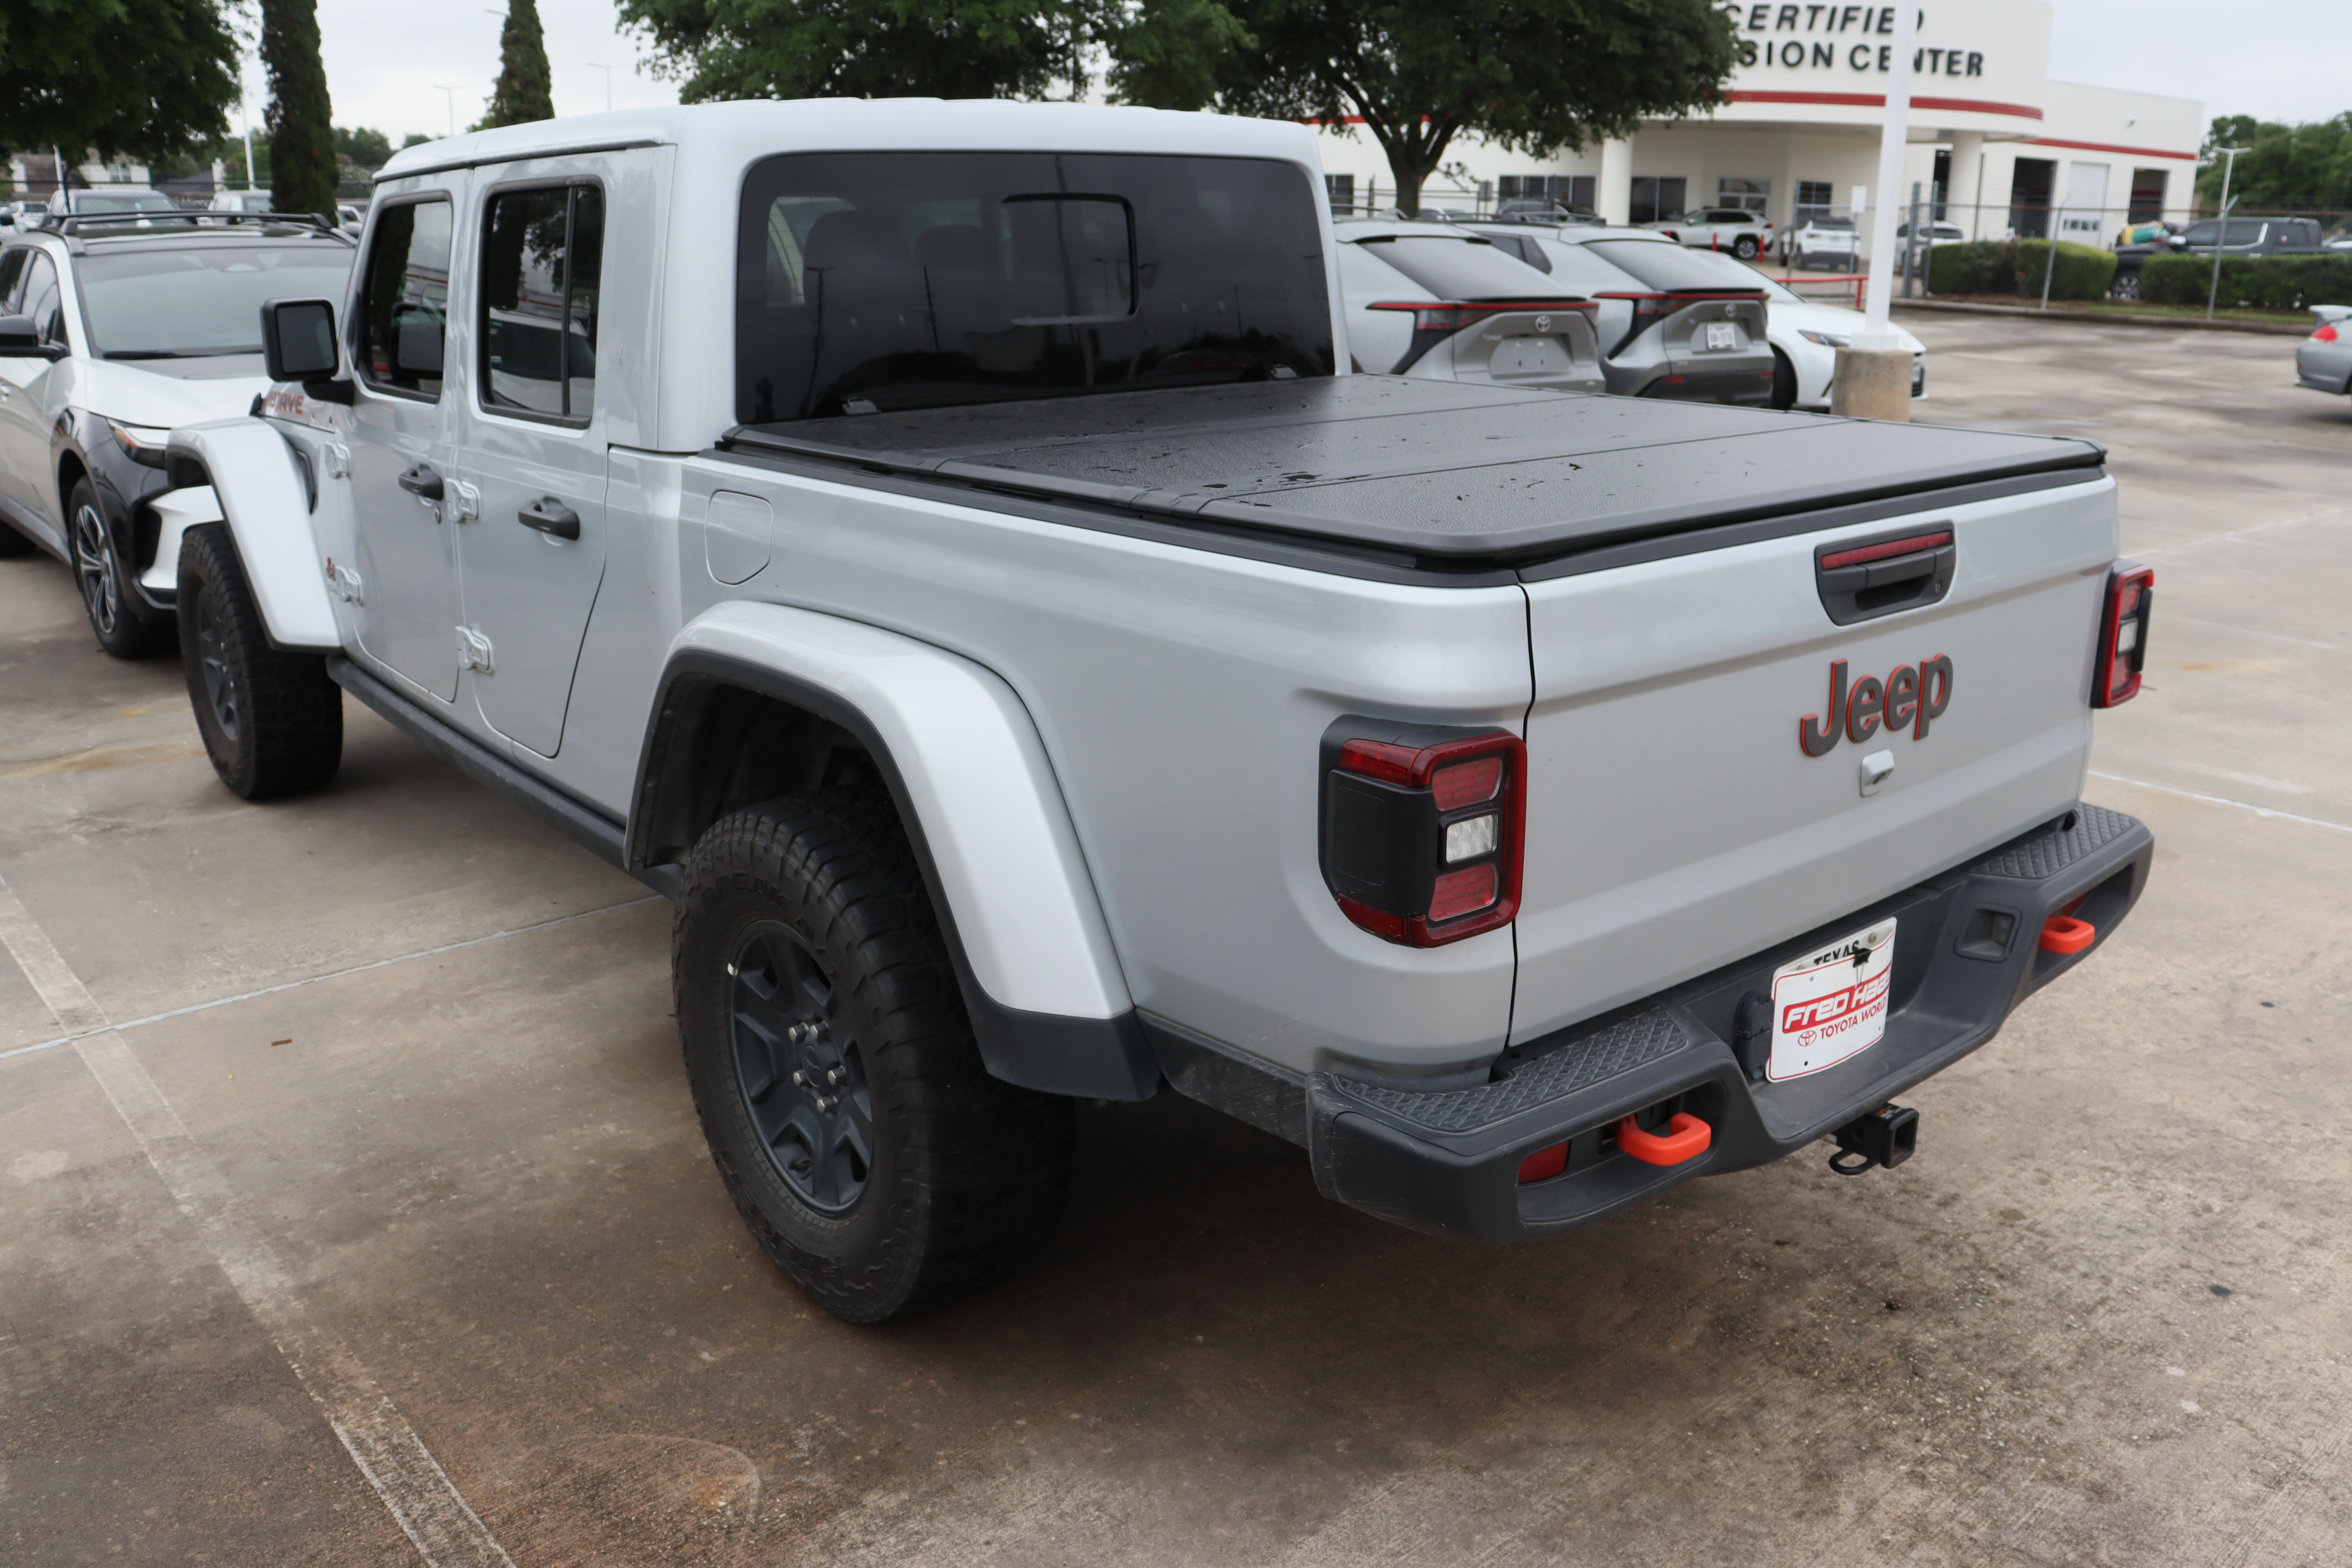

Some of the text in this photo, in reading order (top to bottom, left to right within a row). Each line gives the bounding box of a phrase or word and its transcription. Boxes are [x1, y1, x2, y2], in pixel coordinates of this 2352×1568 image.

[1800, 652, 1954, 757] Jeep
[1820, 997, 1887, 1040] TOYOTA WORLD
